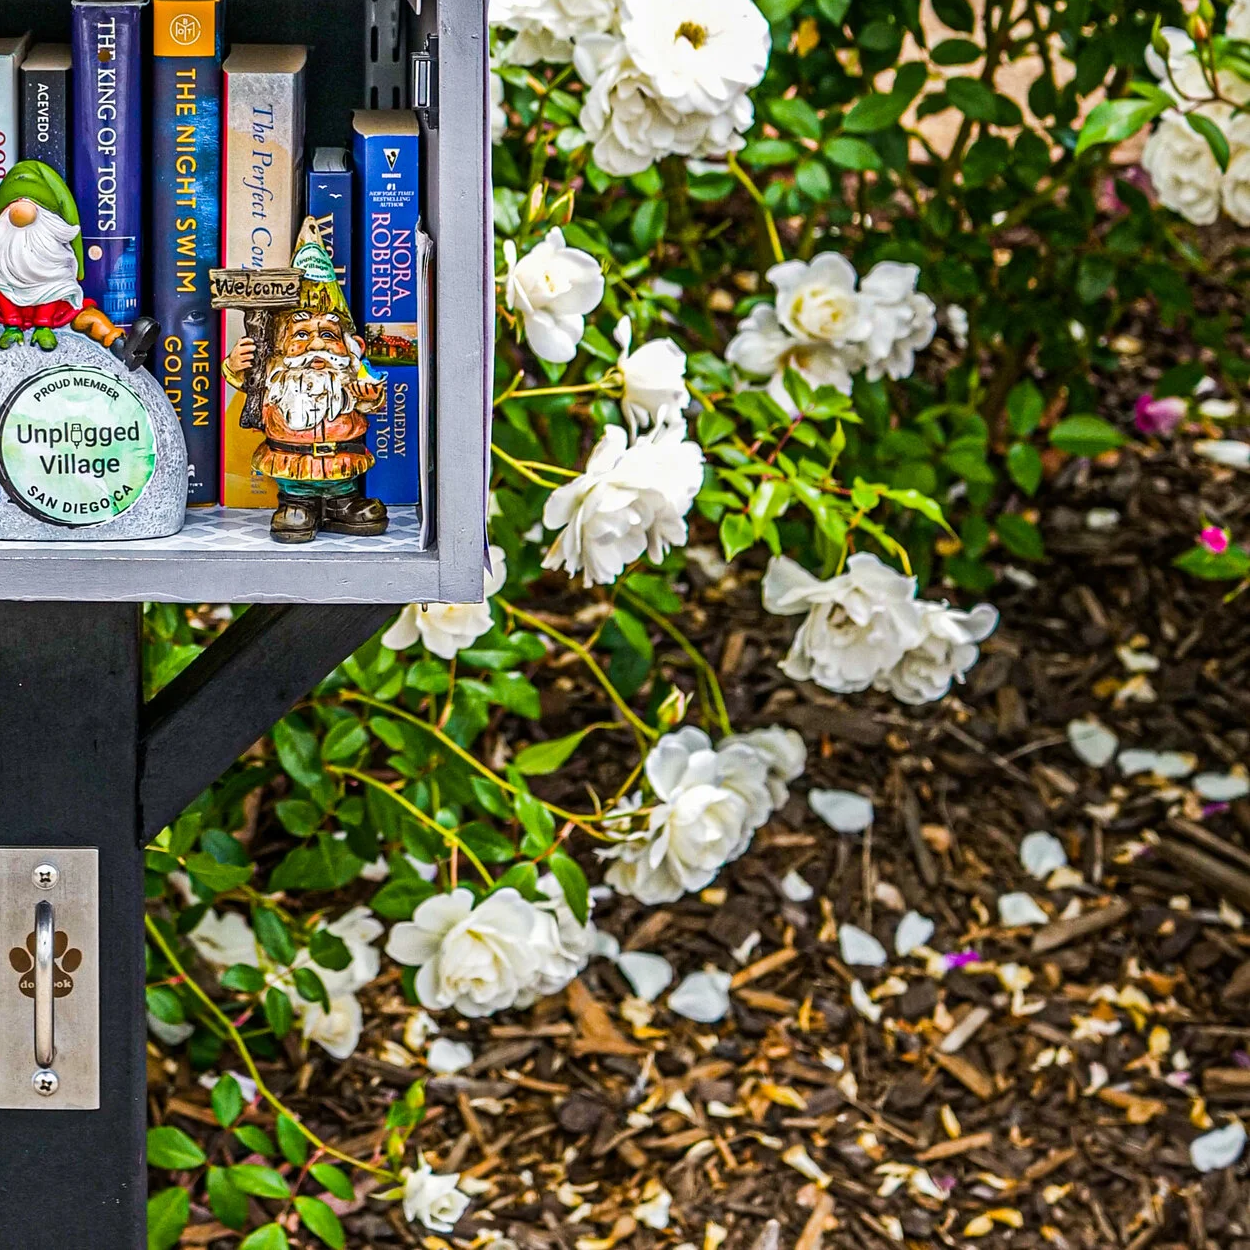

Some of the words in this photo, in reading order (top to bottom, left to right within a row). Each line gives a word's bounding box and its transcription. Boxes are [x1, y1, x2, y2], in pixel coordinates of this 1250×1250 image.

[37, 83, 50, 142] ACEVEDO
[97, 68, 117, 121] KING
[176, 68, 196, 116] THE
[97, 127, 117, 156] OF
[252, 103, 274, 144] The
[176, 125, 197, 209] NIGHT
[242, 151, 274, 221] Perfect
[386, 182, 396, 191] #1
[97, 161, 117, 232] TORTS
[176, 218, 197, 292] SWIM
[371, 212, 391, 317] ROBERTS
[392, 229, 412, 302] NORA
[215, 272, 298, 297] Welcome
[33, 378, 70, 402] PROUD
[73, 377, 120, 401] MEMBER
[192, 339, 210, 426] MEGAN
[376, 426, 390, 459] YOU
[394, 383, 408, 457] SOMEDAY
[39, 453, 120, 478] Village
[27, 485, 58, 510] SAN
